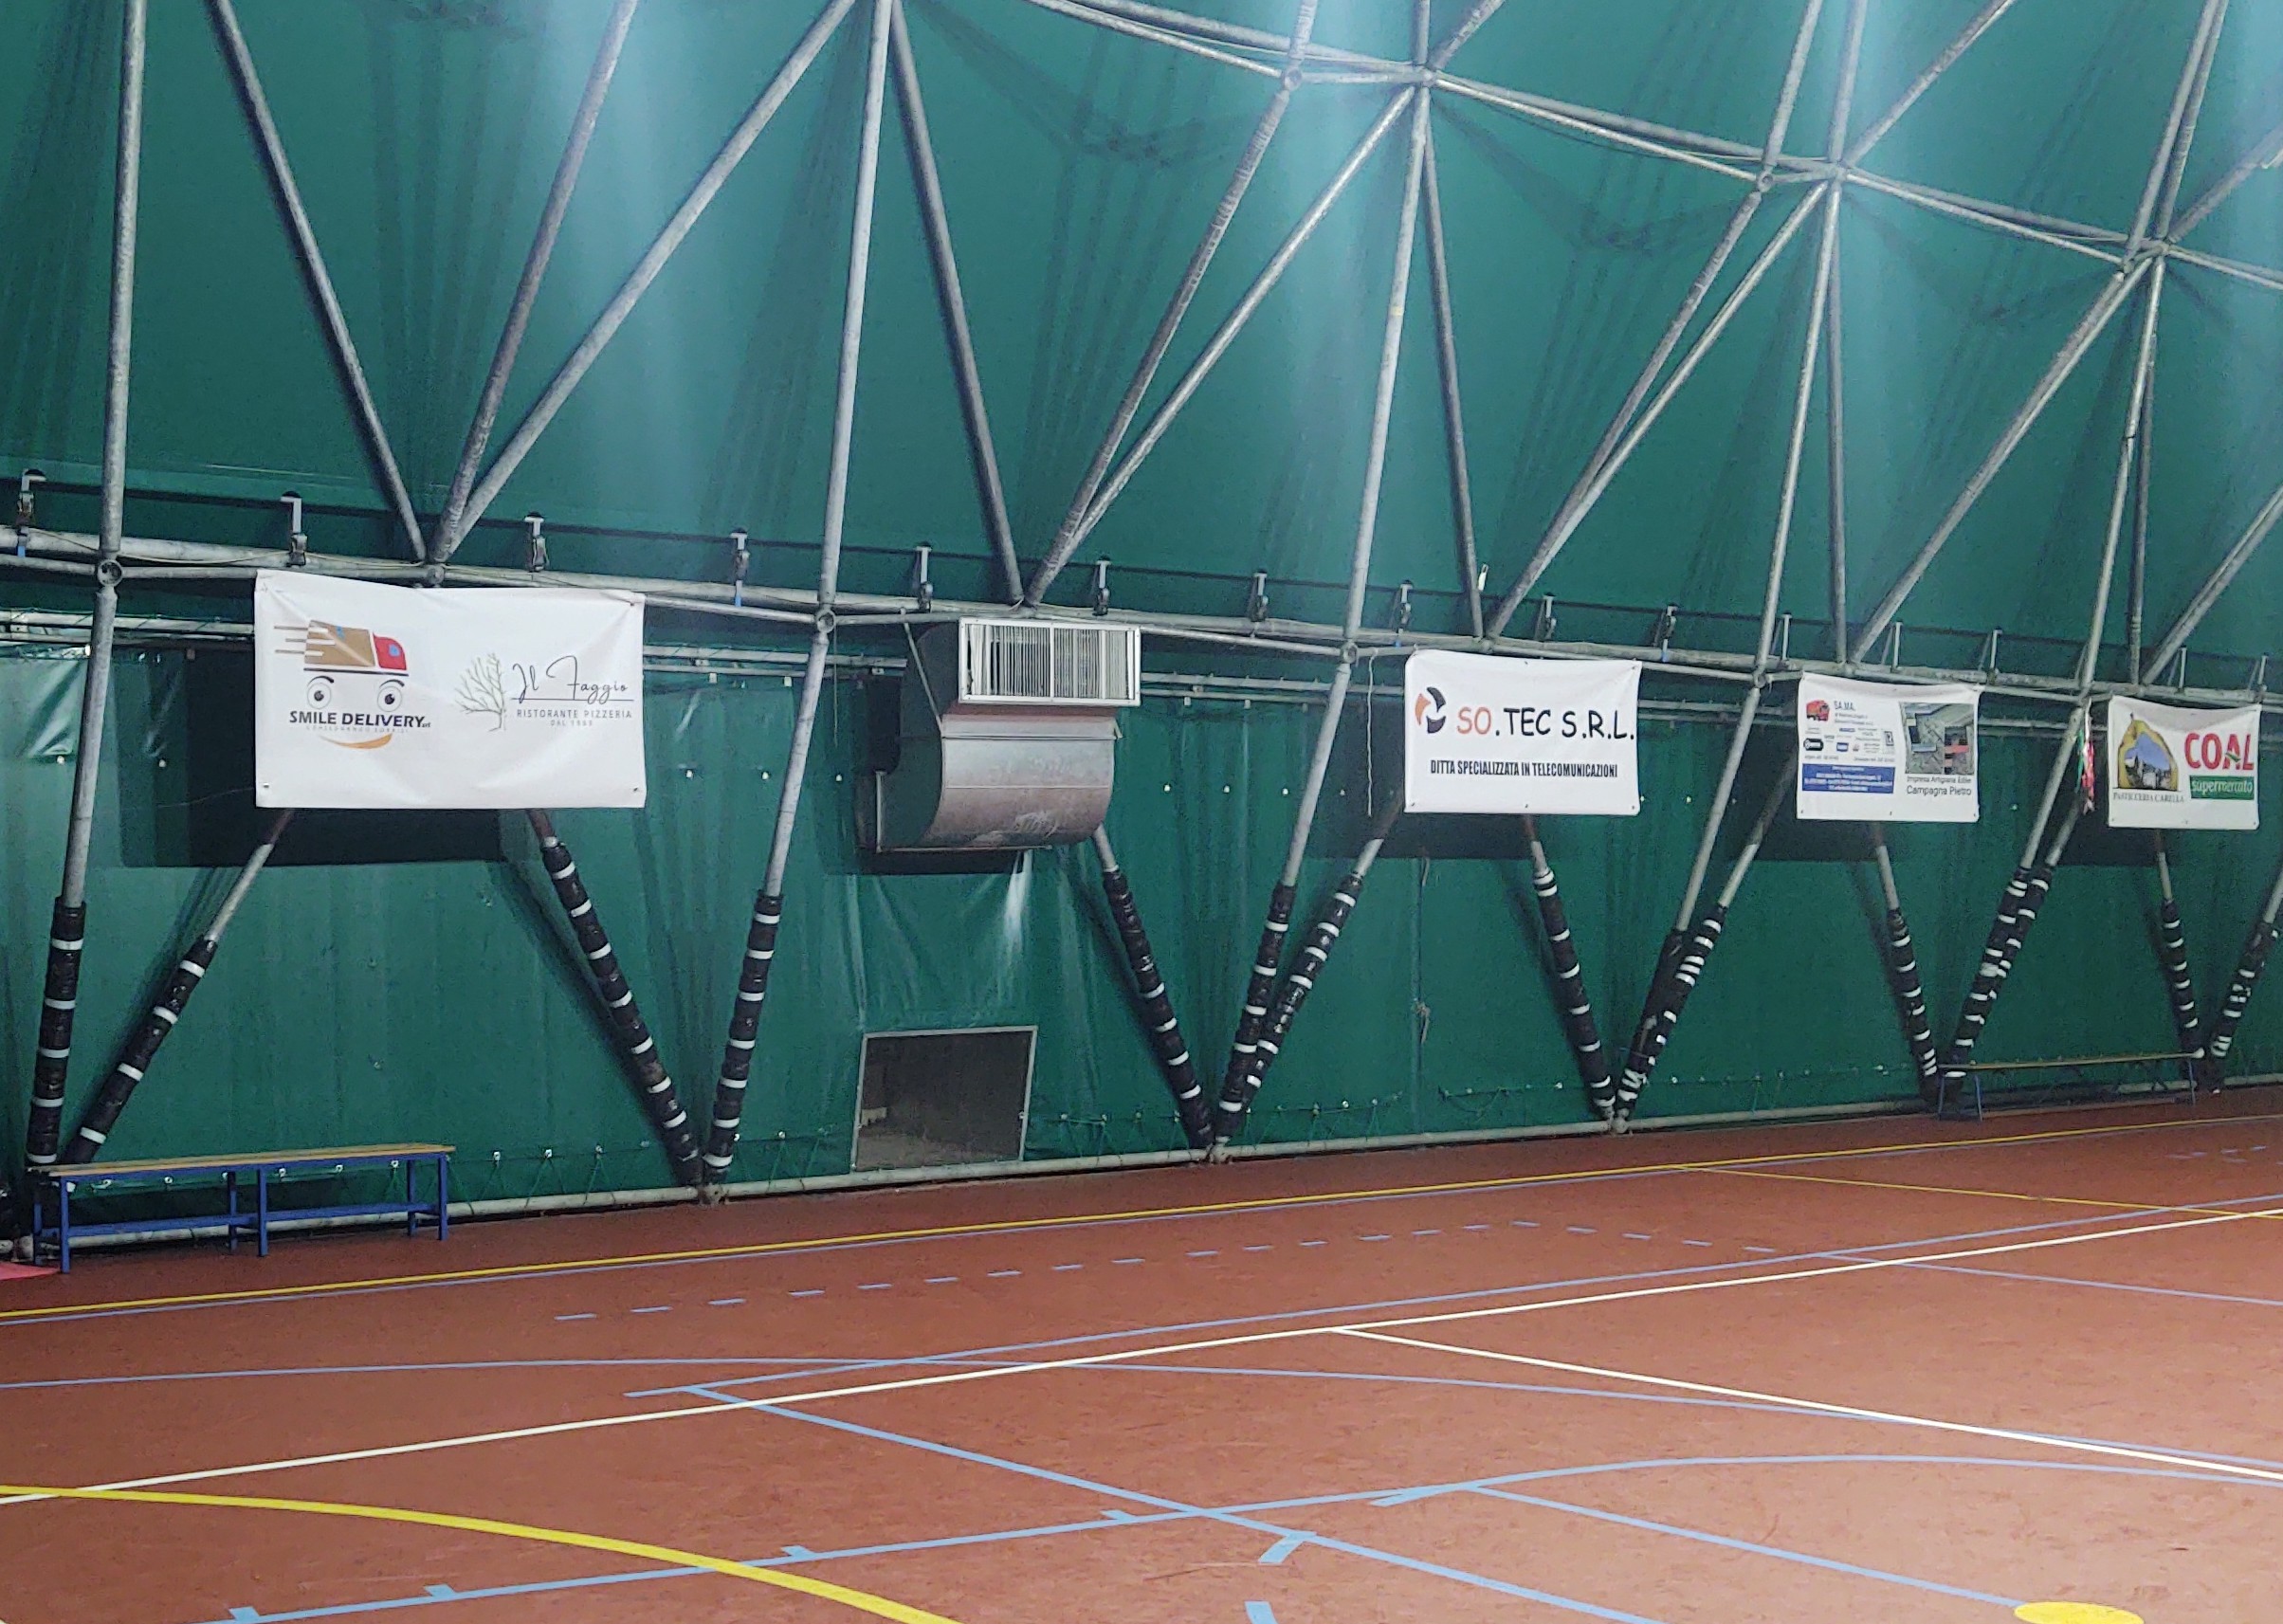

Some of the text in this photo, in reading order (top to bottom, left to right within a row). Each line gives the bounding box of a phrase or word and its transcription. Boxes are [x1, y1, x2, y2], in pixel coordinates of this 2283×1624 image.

[513, 655, 628, 704] Il Faggio
[289, 710, 337, 724] SMILE
[341, 713, 426, 728] DELIVERY
[517, 709, 632, 719] RISTORANTE PIZZERIA
[1456, 706, 1635, 740] SO.TEC S.R.L.
[2184, 732, 2255, 771] COAL
[1431, 759, 1618, 777] DITTA SPECIALIZZATA IN TELECOMUNICAZIONI
[1907, 785, 1972, 797] Campagna Pietro
